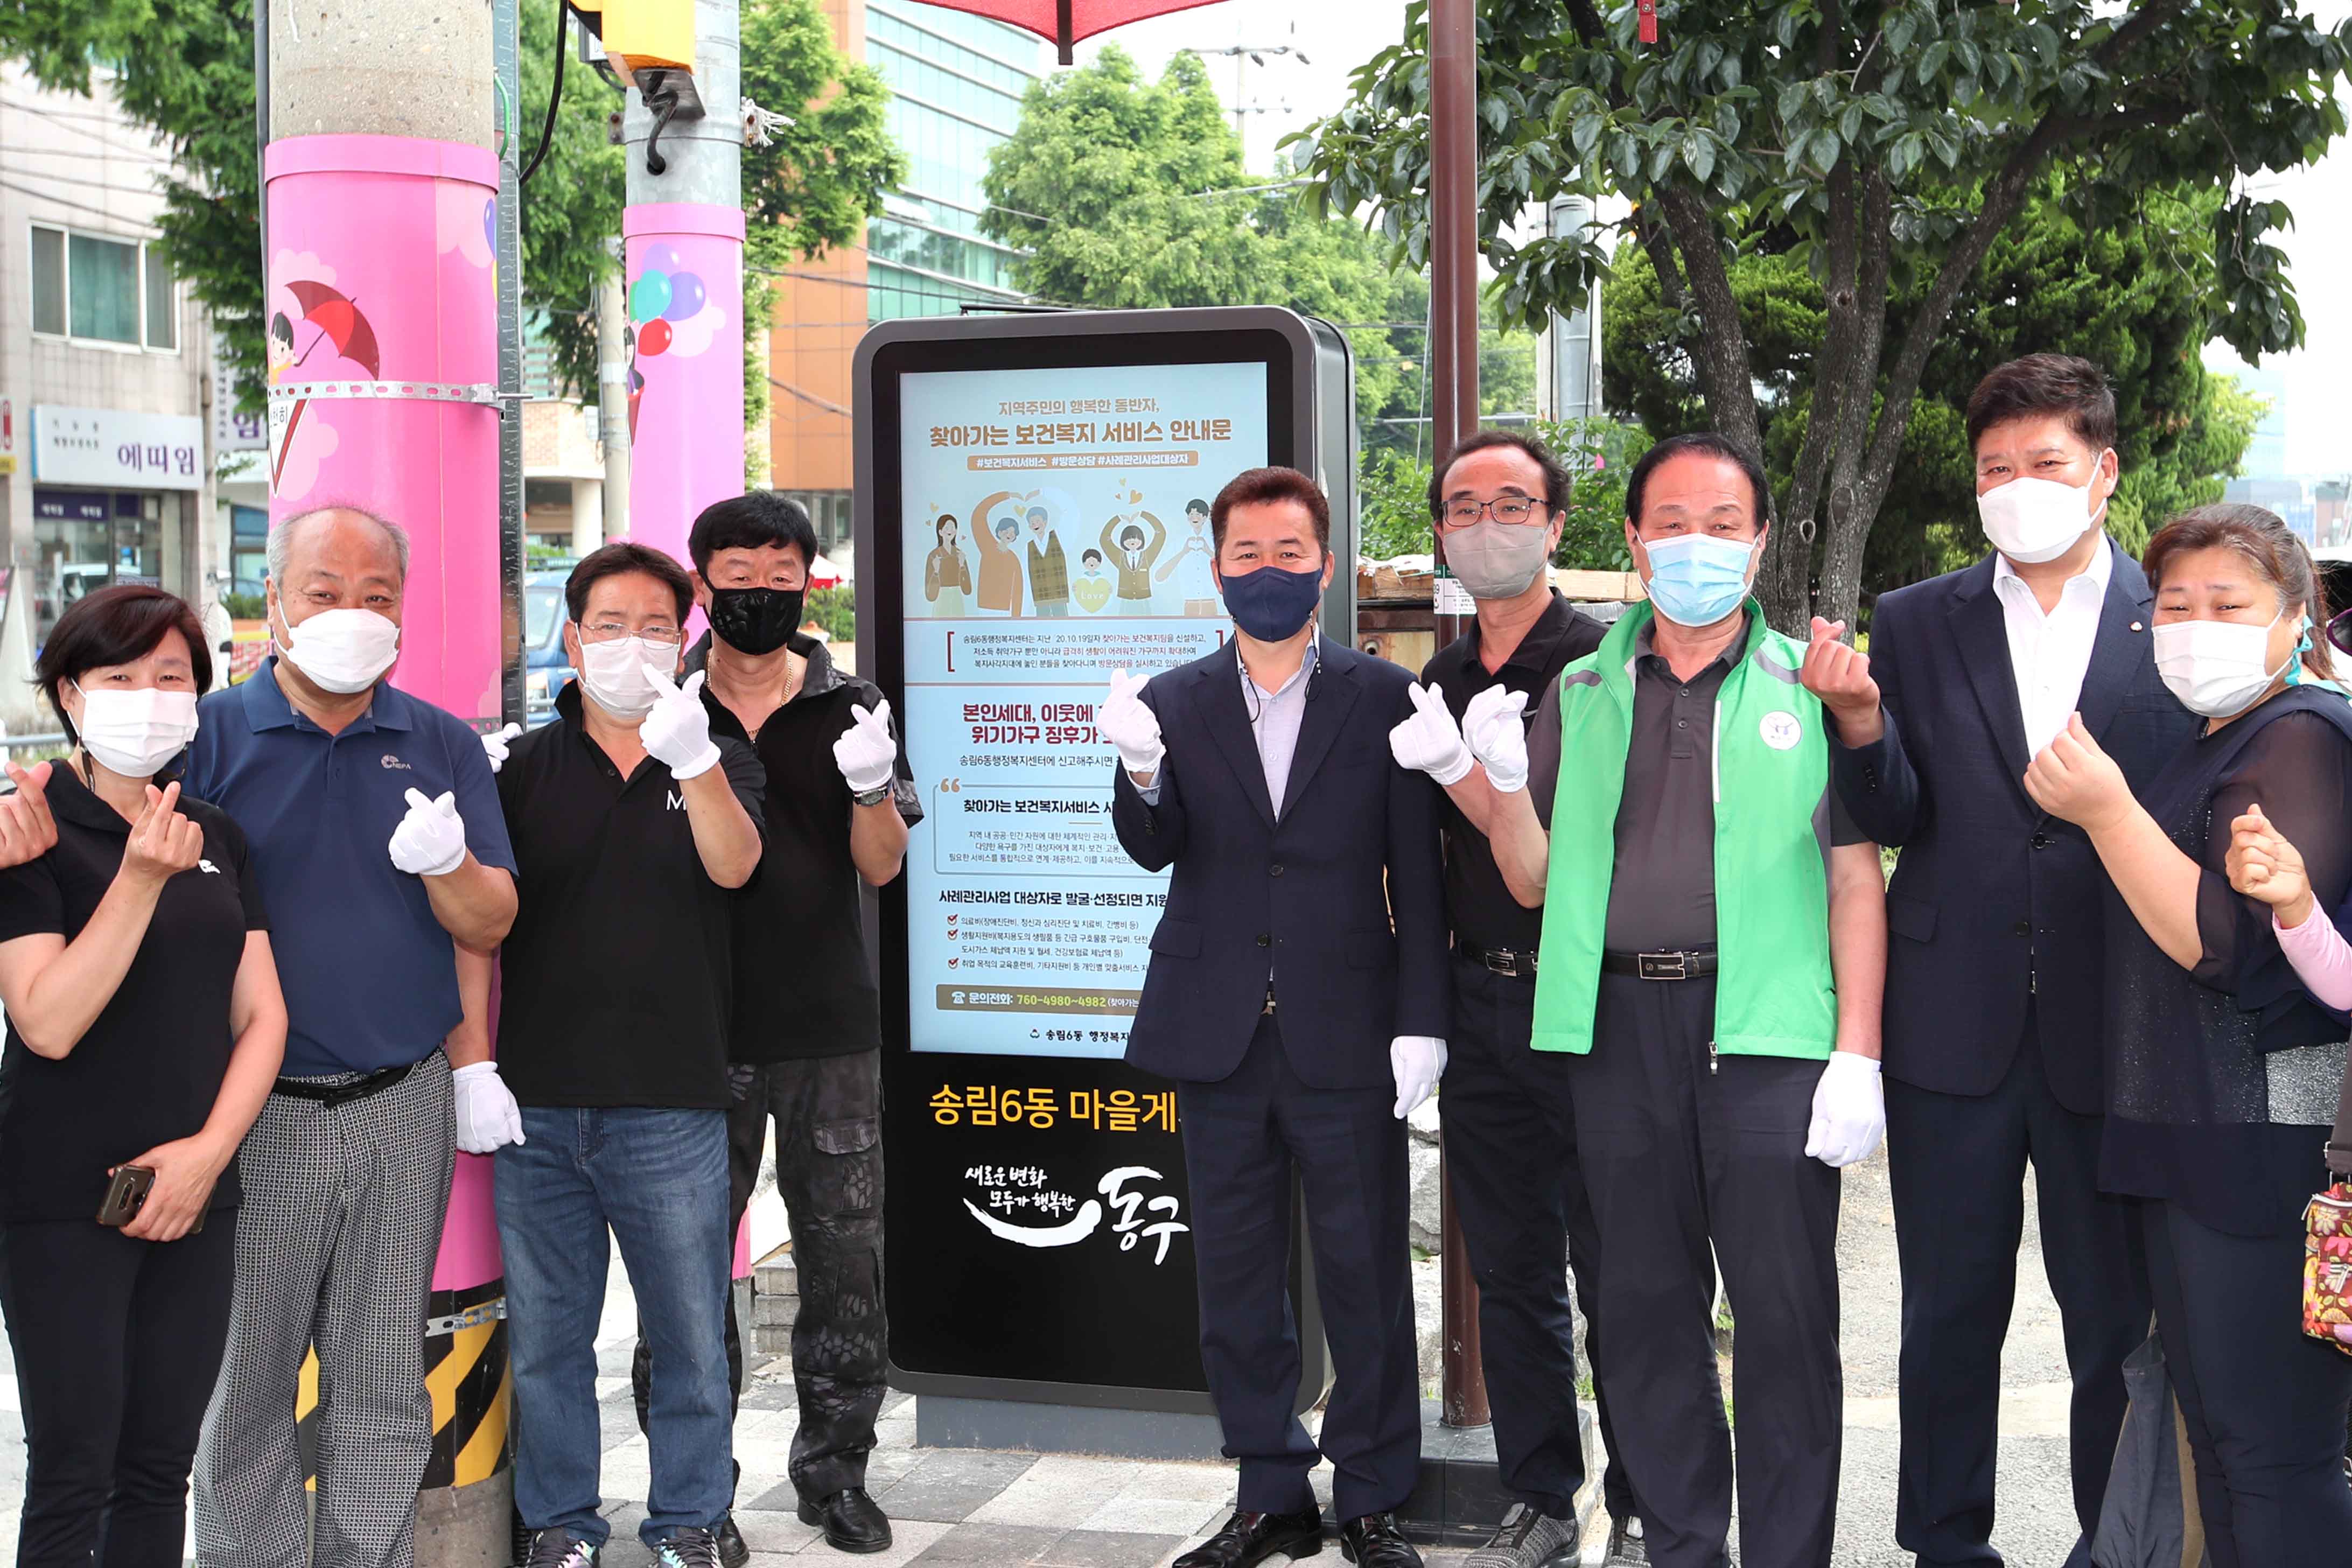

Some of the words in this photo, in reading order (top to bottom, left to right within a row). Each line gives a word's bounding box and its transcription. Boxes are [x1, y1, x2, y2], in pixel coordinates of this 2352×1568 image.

[999, 400, 1066, 416] 지역주민의
[1070, 399, 1111, 414] 행복한
[1114, 398, 1159, 414] 동반자,
[930, 425, 1009, 448] 찾아가는
[1016, 423, 1095, 445] 보건복지
[1102, 421, 1163, 443] 서비스
[1170, 419, 1231, 442] 안내문
[118, 442, 195, 475] 에띠임
[977, 455, 1046, 468] #보건복지서비스
[1052, 454, 1095, 467] #방문상담
[1098, 453, 1189, 466] #사례관리사업대상자
[1037, 635, 1051, 643] 지난
[1103, 634, 1130, 643] 찾아가는
[1062, 659, 1096, 668] 찾아다니며
[963, 704, 1036, 723] 본인세대,
[1041, 703, 1093, 722] 이웃에
[972, 725, 1040, 744] 위기가구
[1045, 725, 1098, 745] 징후가
[959, 755, 1055, 767] 송림6동행정복지센터에
[1058, 756, 1113, 767] 신고해주시면
[964, 800, 1011, 813] 찾아가는
[1015, 800, 1100, 814] 보건복지서비스
[969, 831, 982, 839] 지역
[1025, 831, 1045, 840] 자원에
[1048, 832, 1061, 840] 대한
[976, 843, 995, 851] 다양한
[1020, 843, 1033, 852] 가진
[939, 890, 1011, 904] 사례관리사업
[1014, 891, 1061, 905] 대상자로
[961, 945, 988, 954] 도시가스
[969, 992, 1013, 1005] 문의전화:
[1017, 993, 1106, 1008] 760-4980~4982
[1046, 1030, 1083, 1042] 송림6동
[929, 1083, 1059, 1129] 송림6동
[1069, 1088, 1176, 1133] 마을게
[964, 1164, 1007, 1187] 새로운
[1009, 1166, 1047, 1189] 변화
[990, 1191, 1029, 1215] 모두가
[1031, 1191, 1076, 1219] 행복한
[1098, 1166, 1190, 1266] 동구
